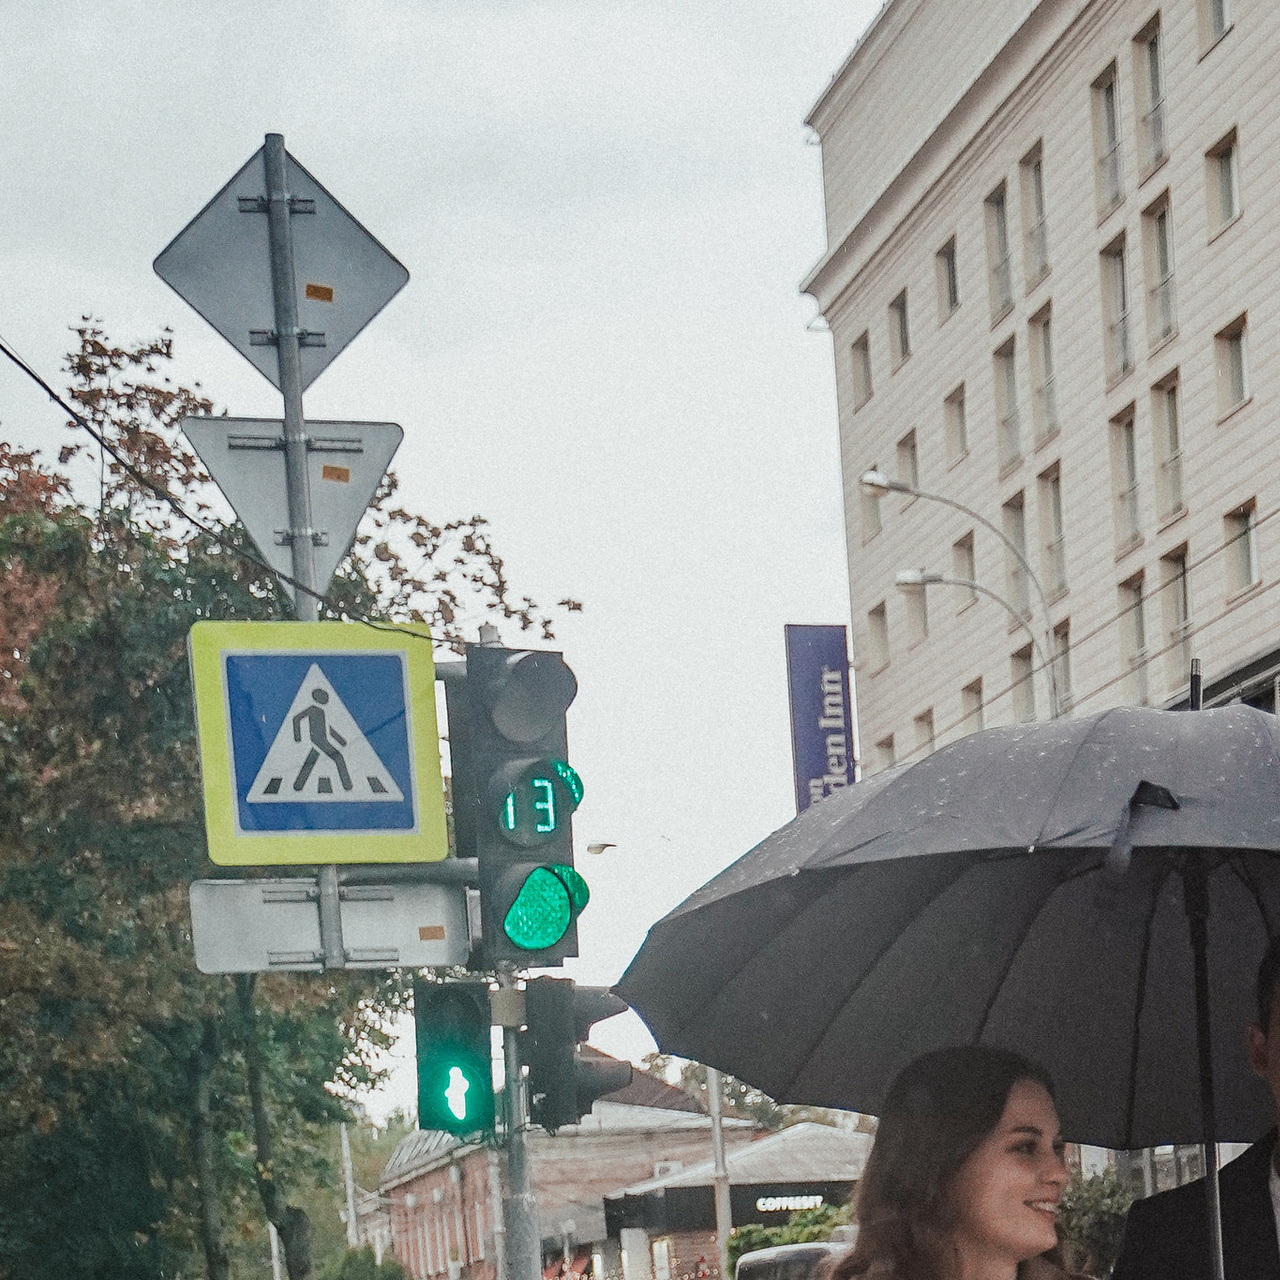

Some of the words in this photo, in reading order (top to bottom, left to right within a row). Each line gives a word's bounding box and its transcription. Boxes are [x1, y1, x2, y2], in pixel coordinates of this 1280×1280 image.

[819, 670, 845, 729] Inn
[822, 733, 848, 792] den
[506, 778, 556, 832] 13
